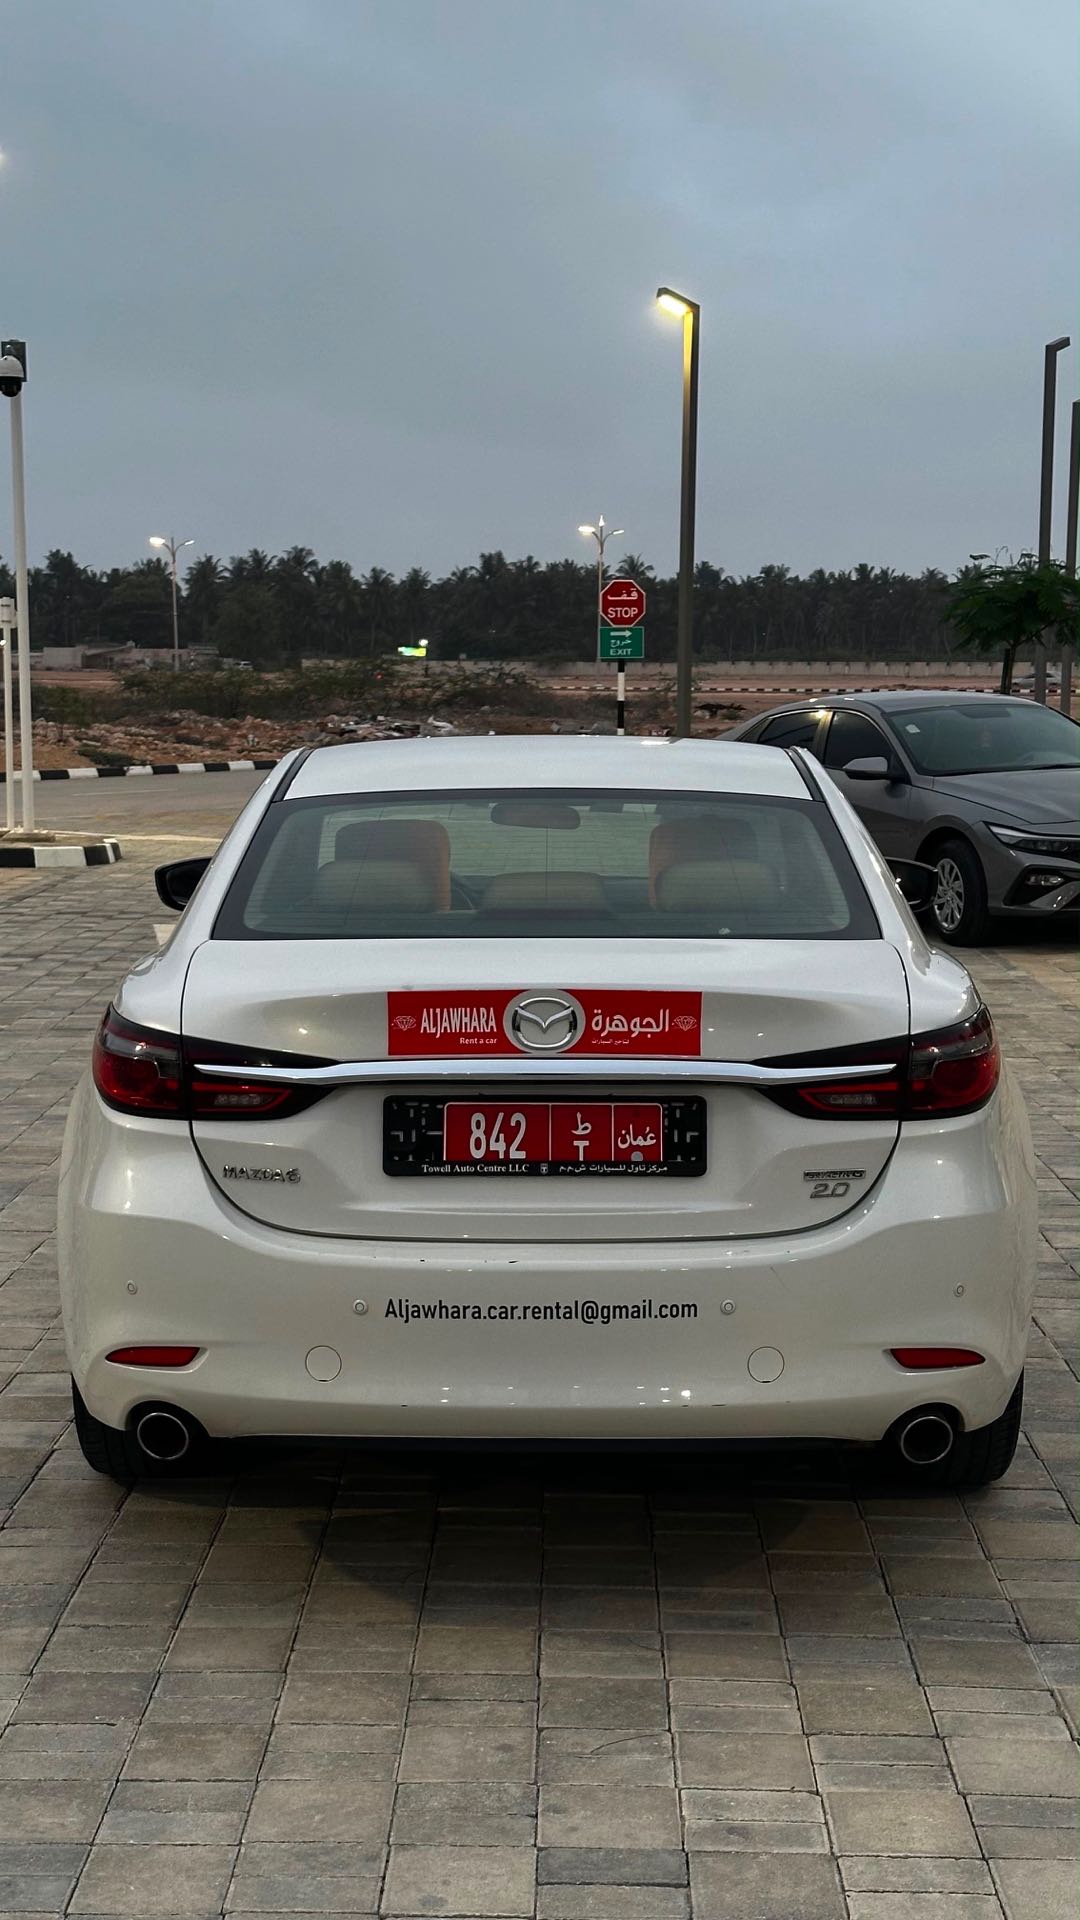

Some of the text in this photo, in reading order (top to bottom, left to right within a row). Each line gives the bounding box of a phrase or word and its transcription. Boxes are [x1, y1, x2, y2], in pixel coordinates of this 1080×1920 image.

[607, 588, 639, 600] قف
[607, 607, 639, 618] STOP
[610, 638, 632, 647] خروج
[609, 648, 632, 656] EXIT
[420, 1007, 497, 1039] ALJAWHARA
[591, 1008, 670, 1038] الجوهرة
[459, 1037, 478, 1045] Rent
[571, 1111, 592, 1135] ط
[469, 1112, 526, 1159] 842
[573, 1140, 590, 1161] T
[421, 1164, 530, 1173] Towell Auto Centre LLC
[647, 1164, 668, 1173] مركز
[384, 1298, 698, 1324] Aljawhara.car.rental@gmail.com
